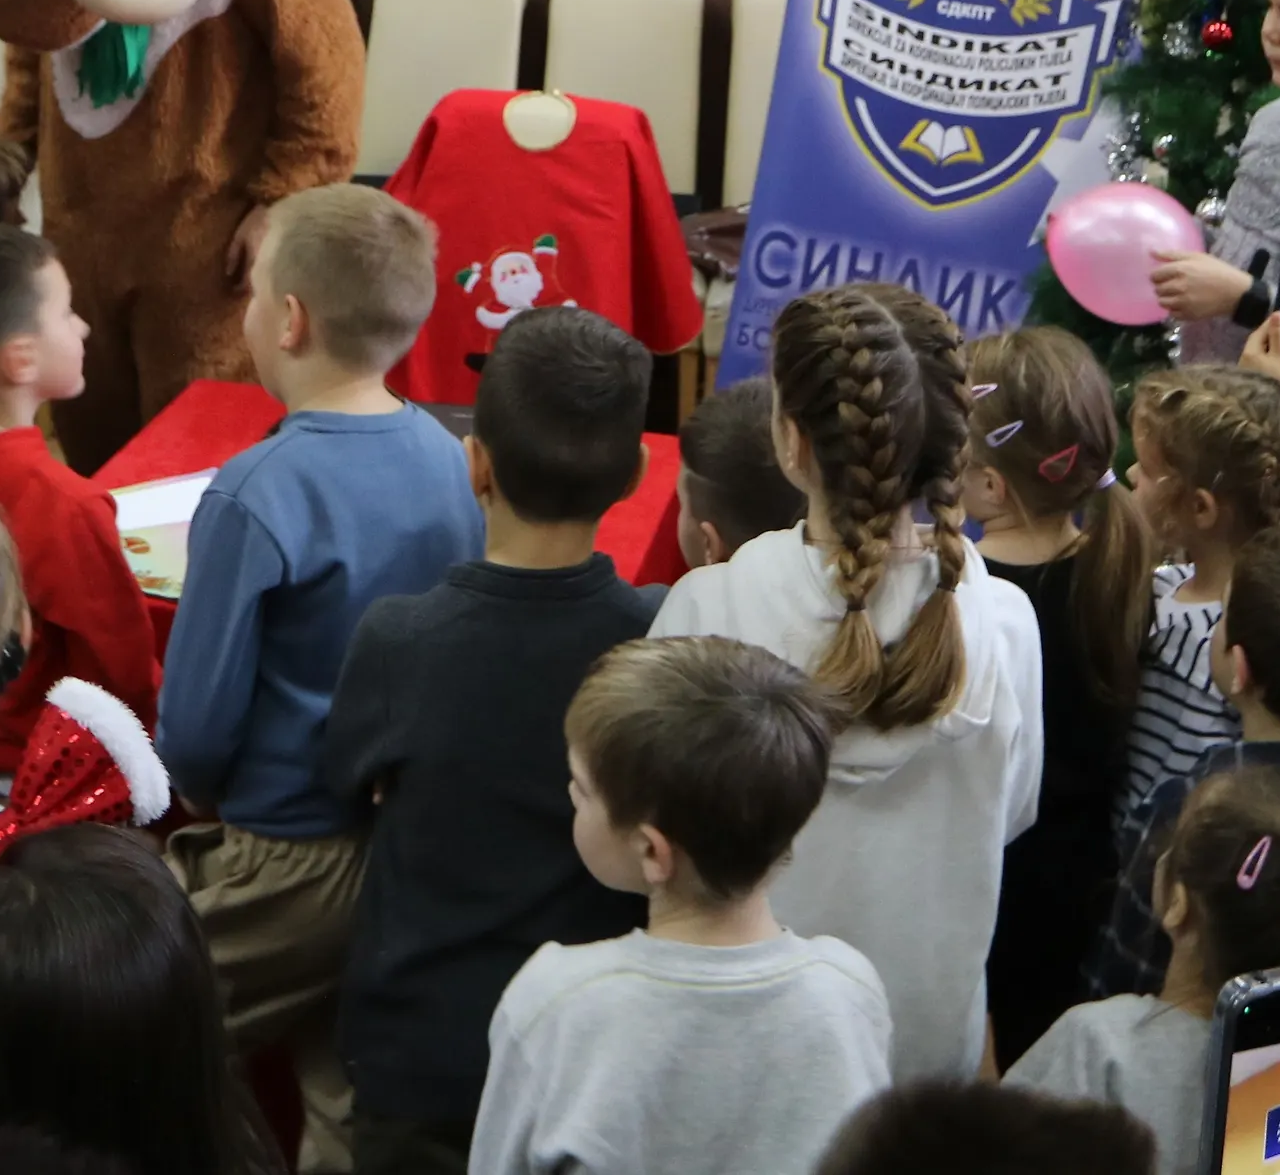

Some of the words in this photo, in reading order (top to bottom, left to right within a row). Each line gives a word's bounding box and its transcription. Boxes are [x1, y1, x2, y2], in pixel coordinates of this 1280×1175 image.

[851, 1, 1079, 53] SINDIKAT
[936, 0, 995, 21] СДКПТ
[843, 39, 1072, 91] СИНДИКАТ
